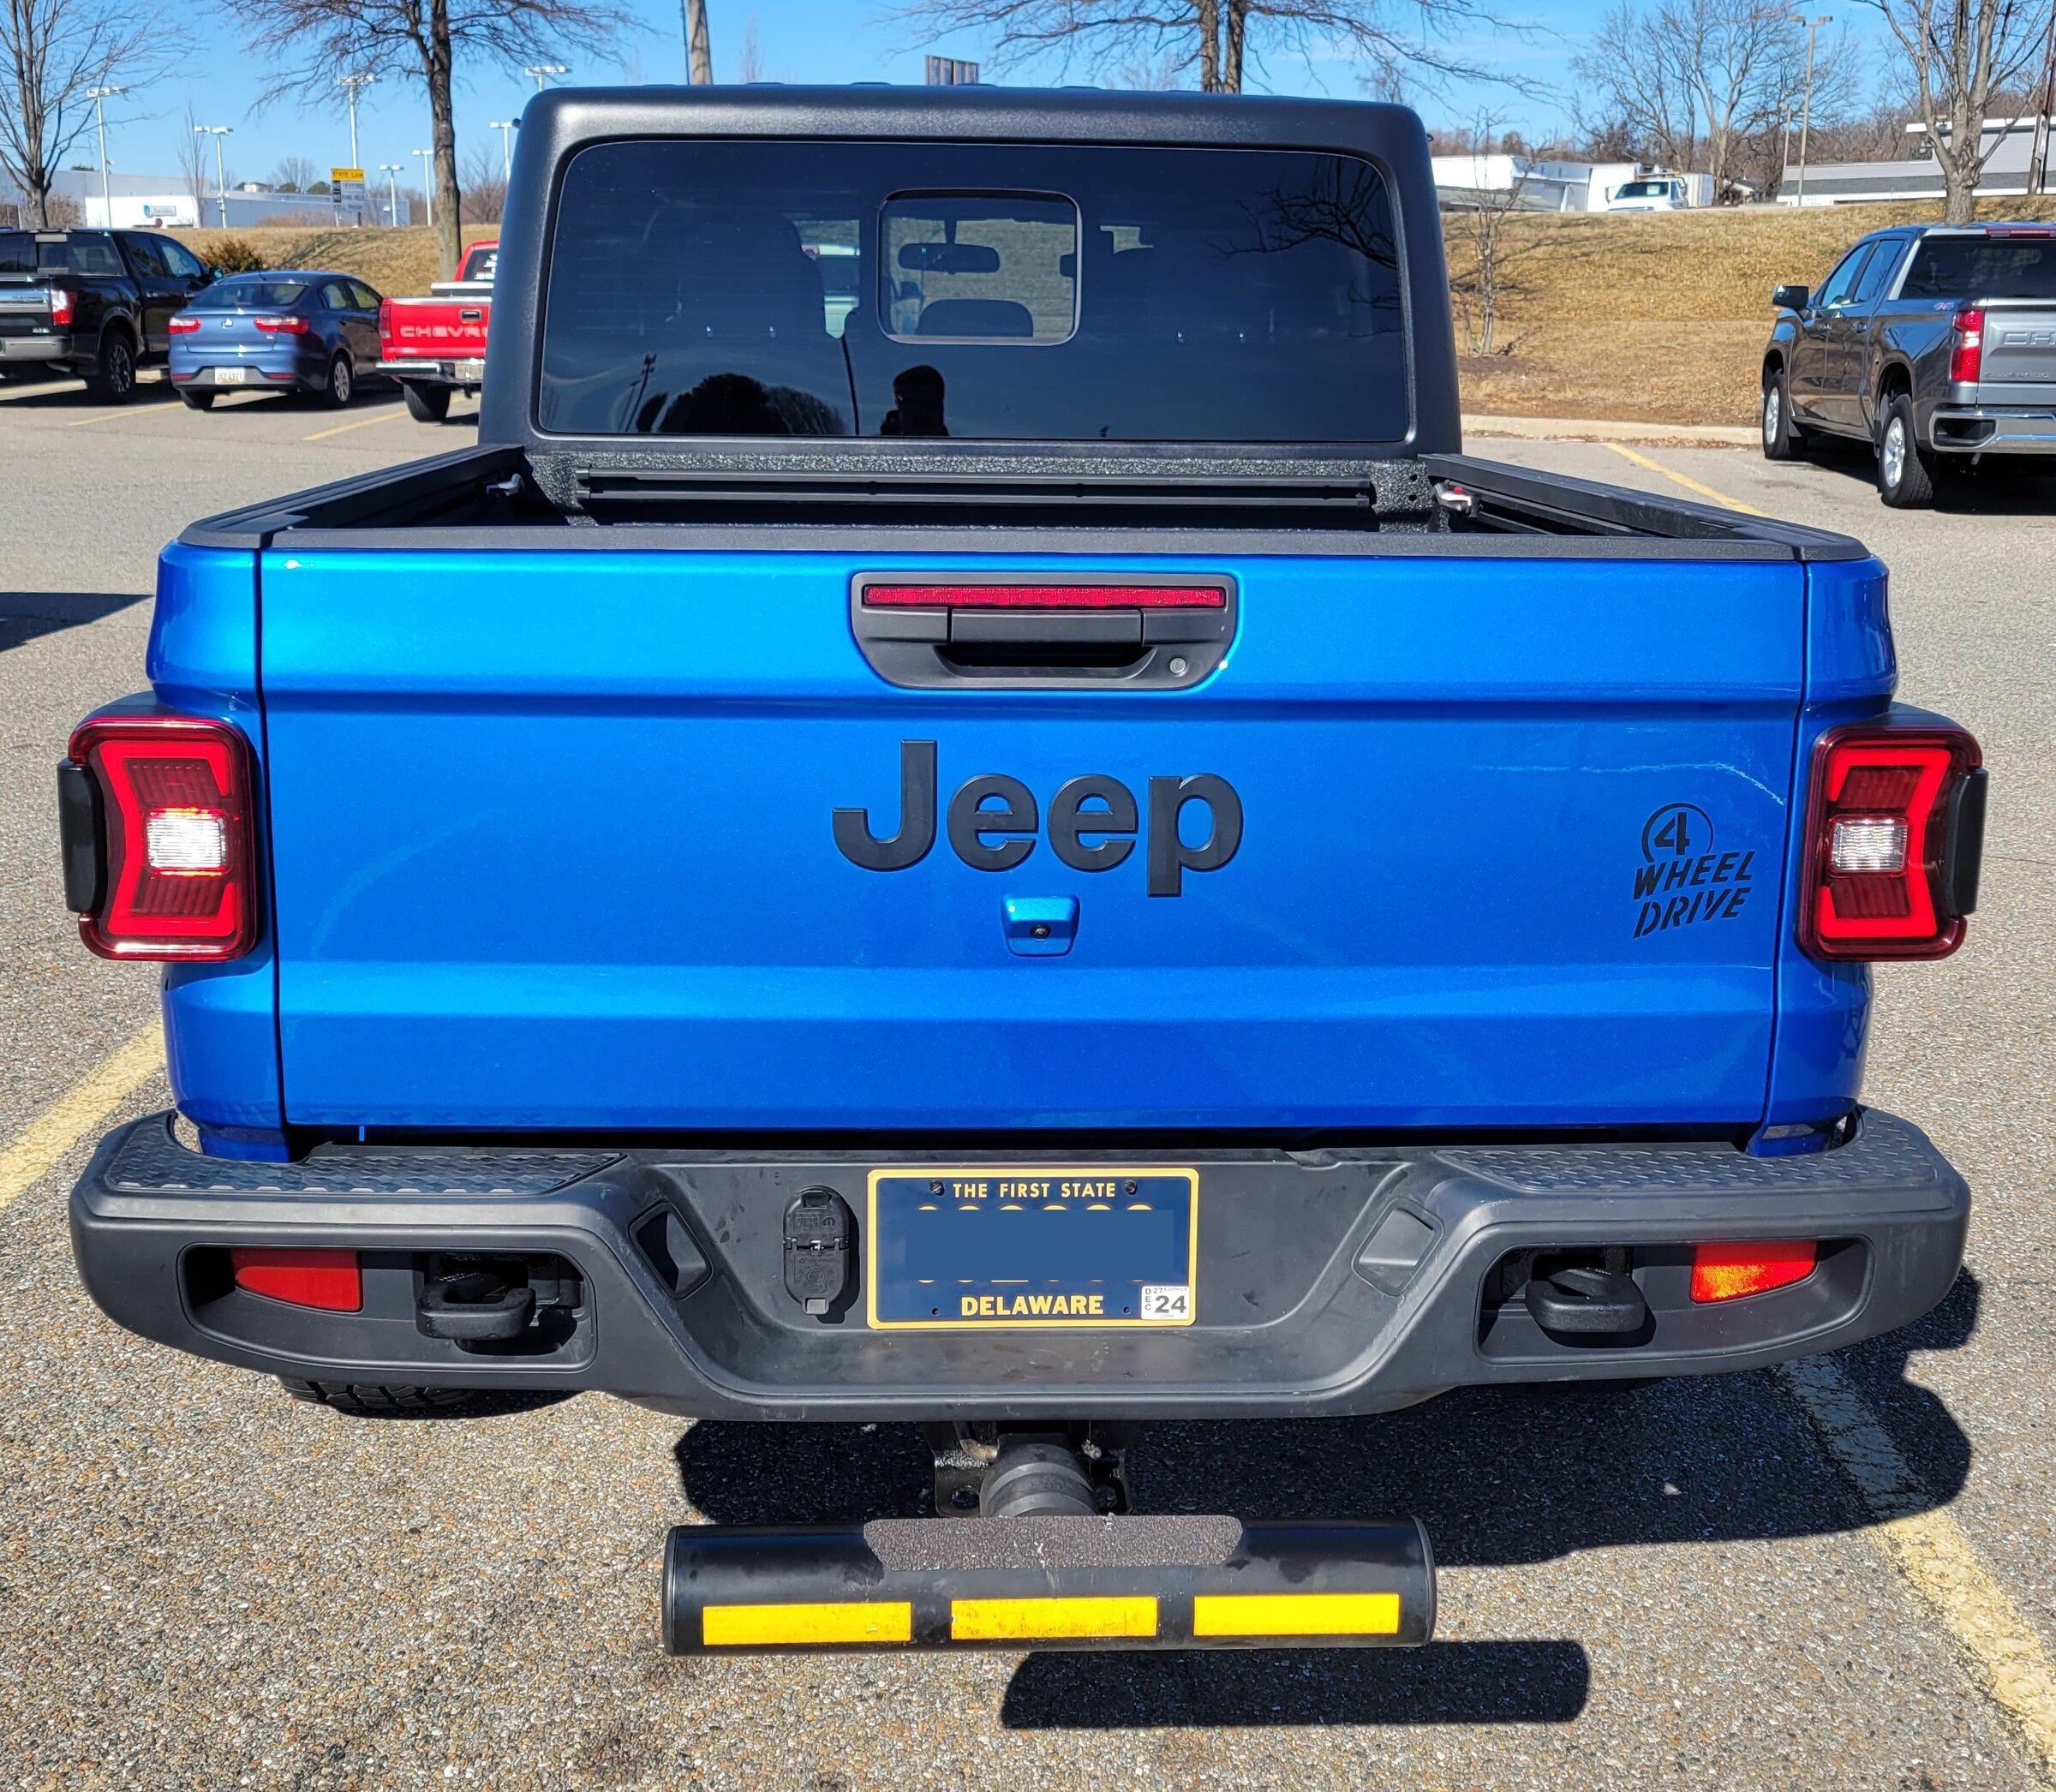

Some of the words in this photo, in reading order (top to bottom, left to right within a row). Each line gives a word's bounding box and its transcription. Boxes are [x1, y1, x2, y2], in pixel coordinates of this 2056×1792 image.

[833, 739, 1244, 898] Jeep
[1653, 812, 1690, 856] 4
[1633, 851, 1756, 900] WHEEL
[1633, 887, 1743, 939] DRIVE
[953, 1183, 988, 1198] THE
[1000, 1183, 1050, 1198] FIRST
[1061, 1182, 1116, 1198] STATE
[960, 1294, 1104, 1316] DELAWARE
[1154, 1295, 1186, 1313] 24
